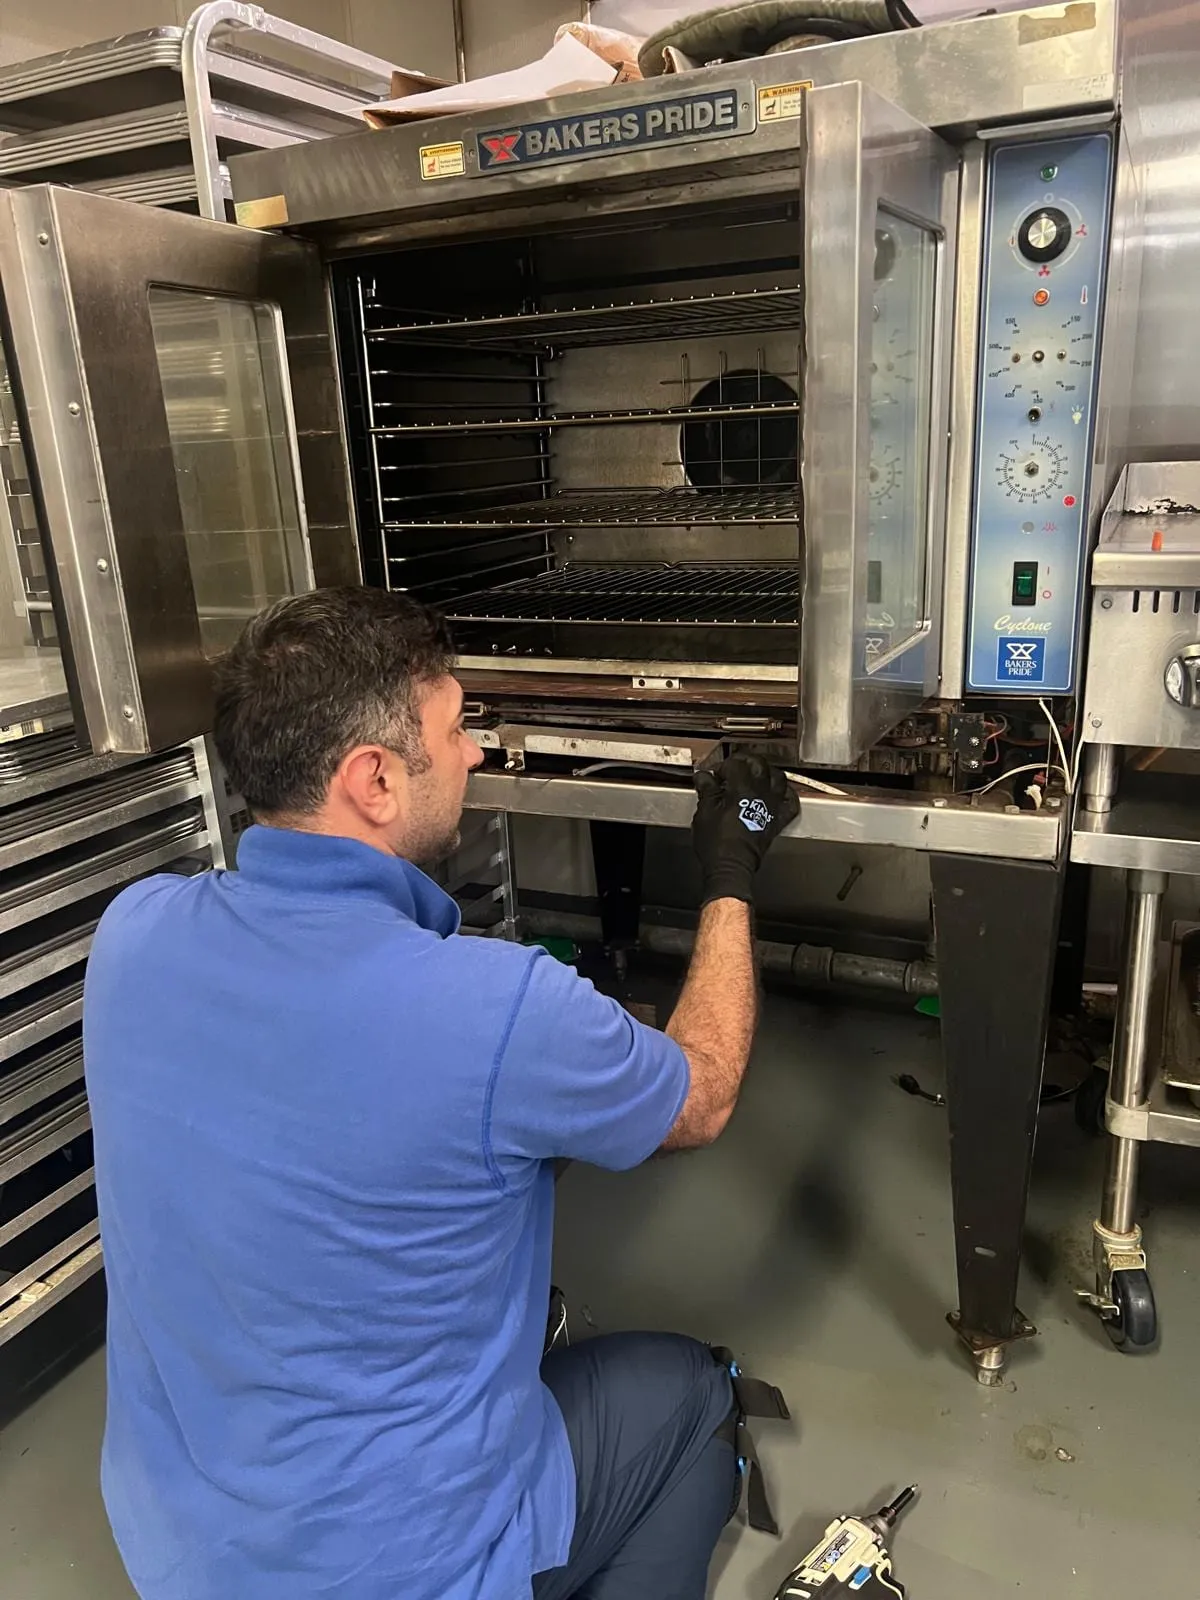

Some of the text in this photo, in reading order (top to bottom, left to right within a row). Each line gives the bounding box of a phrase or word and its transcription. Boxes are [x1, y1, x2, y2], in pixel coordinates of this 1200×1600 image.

[525, 97, 734, 156] BAKERS PRIDE
[993, 614, 1052, 635] Cyclone
[1005, 660, 1037, 668] BAKERS
[1008, 667, 1033, 676] PRIDE
